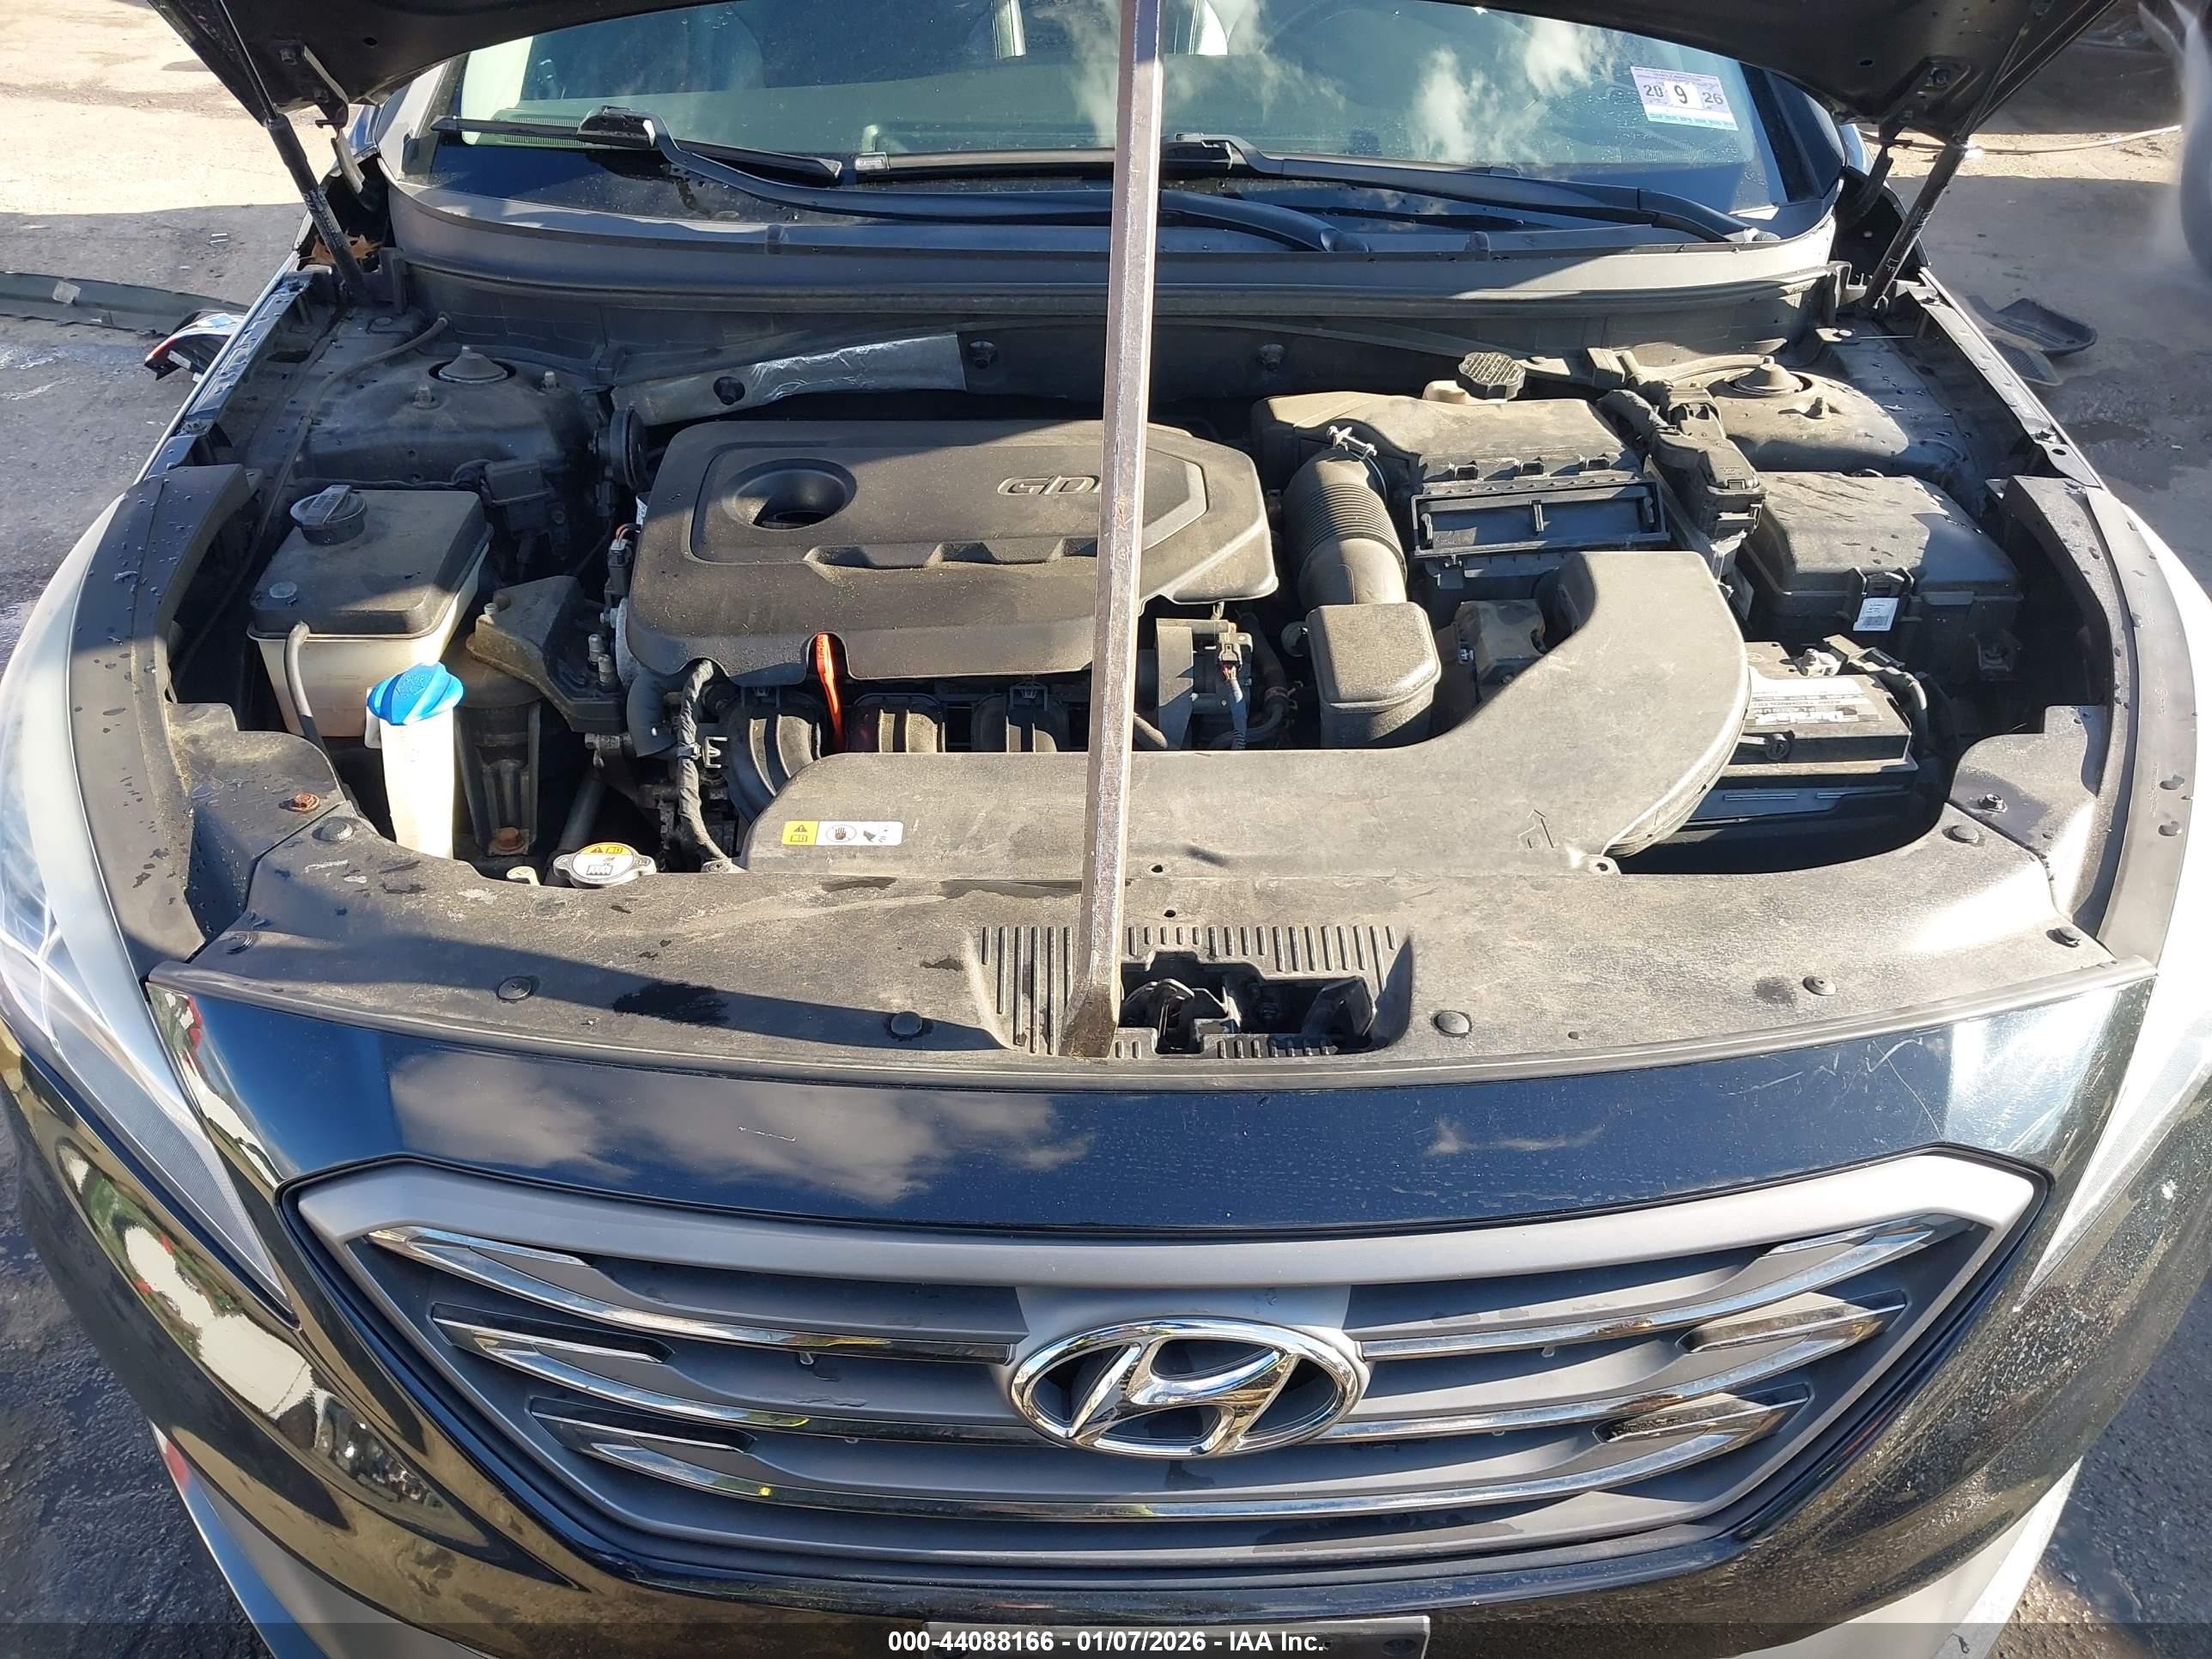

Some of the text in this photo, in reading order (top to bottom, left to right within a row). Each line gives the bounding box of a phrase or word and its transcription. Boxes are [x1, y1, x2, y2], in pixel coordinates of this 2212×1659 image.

[1643, 84, 1724, 105] 20 9 26
[997, 474, 1102, 495] GD
[1754, 711, 1844, 726] Duralast
